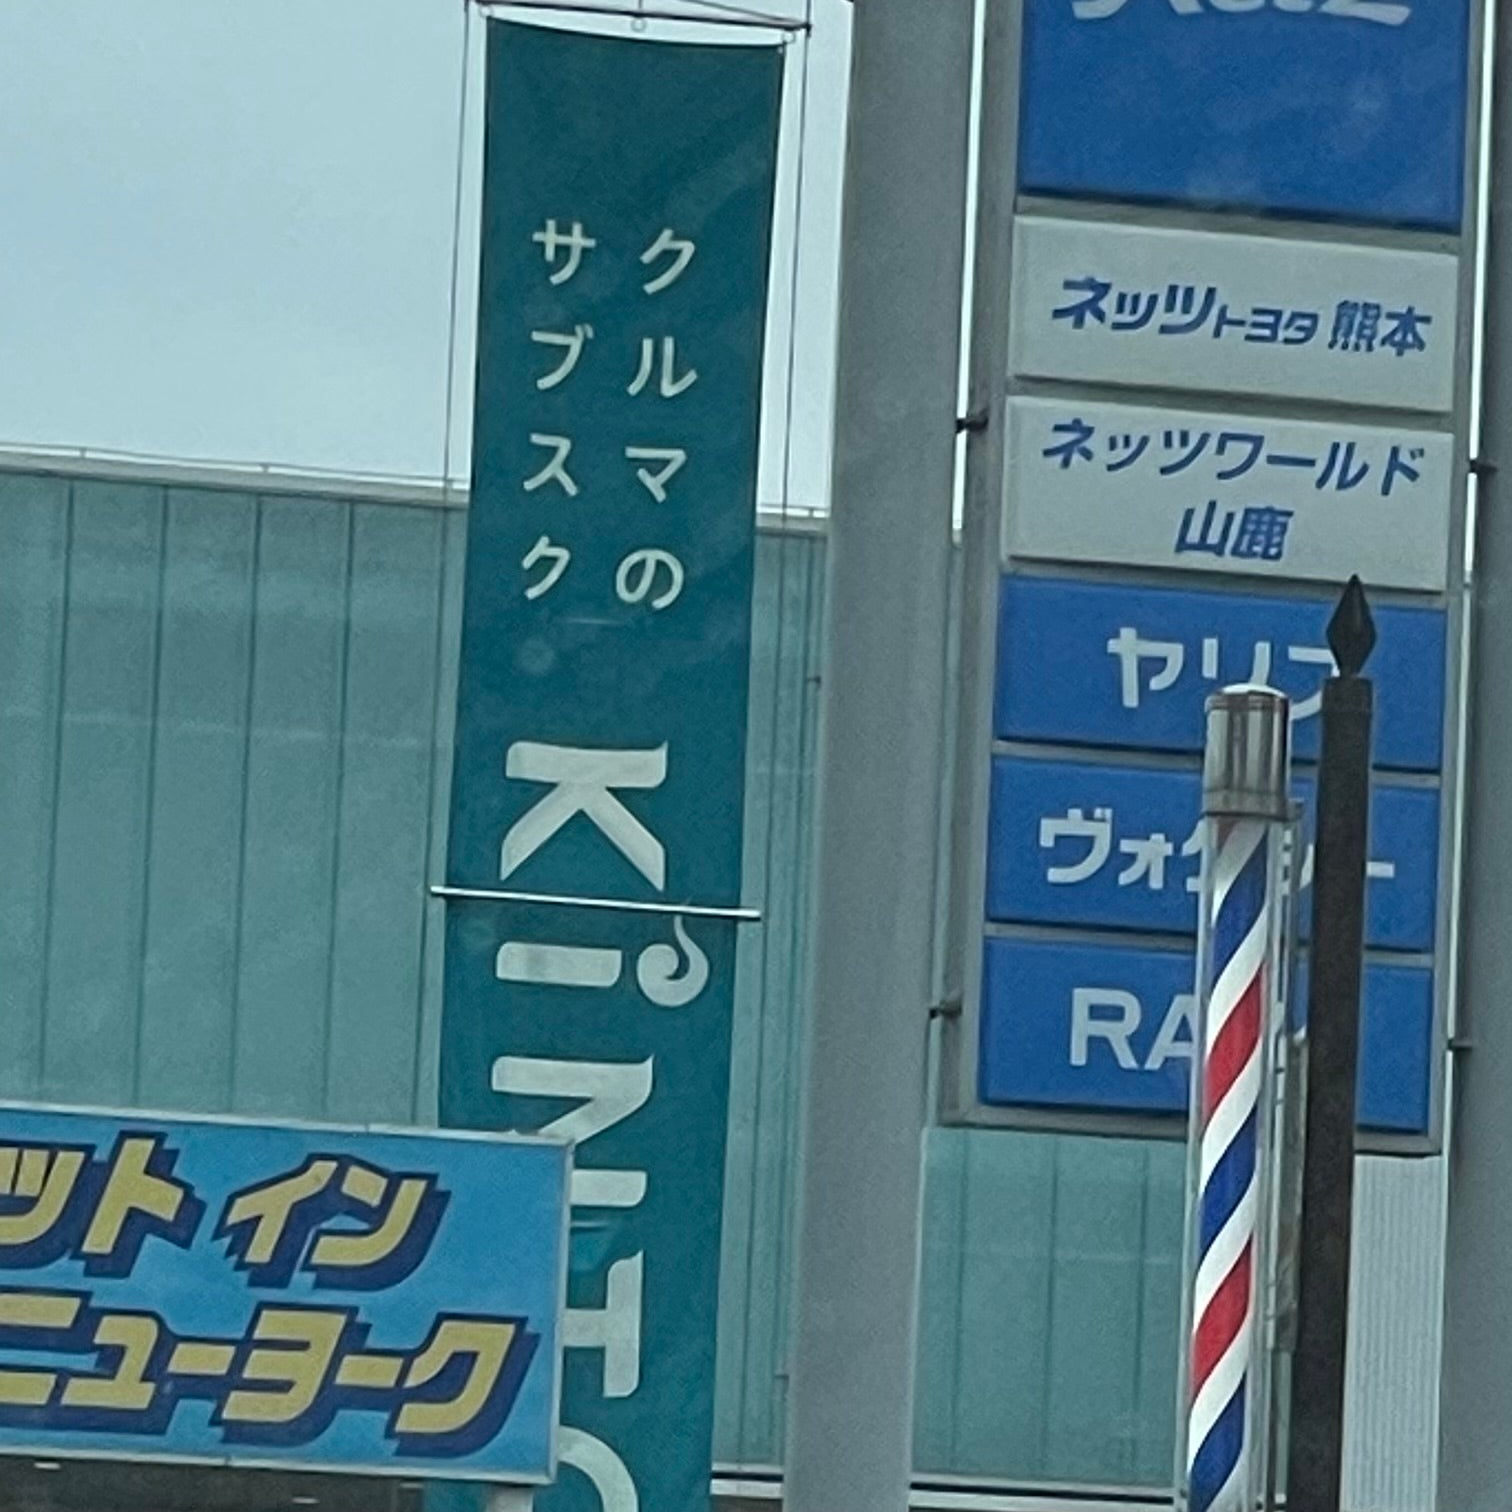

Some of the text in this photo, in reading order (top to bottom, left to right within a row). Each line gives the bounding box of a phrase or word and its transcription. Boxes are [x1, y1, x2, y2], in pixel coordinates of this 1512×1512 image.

[521, 218, 597, 600] サブスク
[615, 228, 698, 609] クルマの
[1042, 418, 1425, 496] ネッツワールド
[1174, 500, 1295, 561] 山鹿
[490, 740, 709, 1512] KiNT
